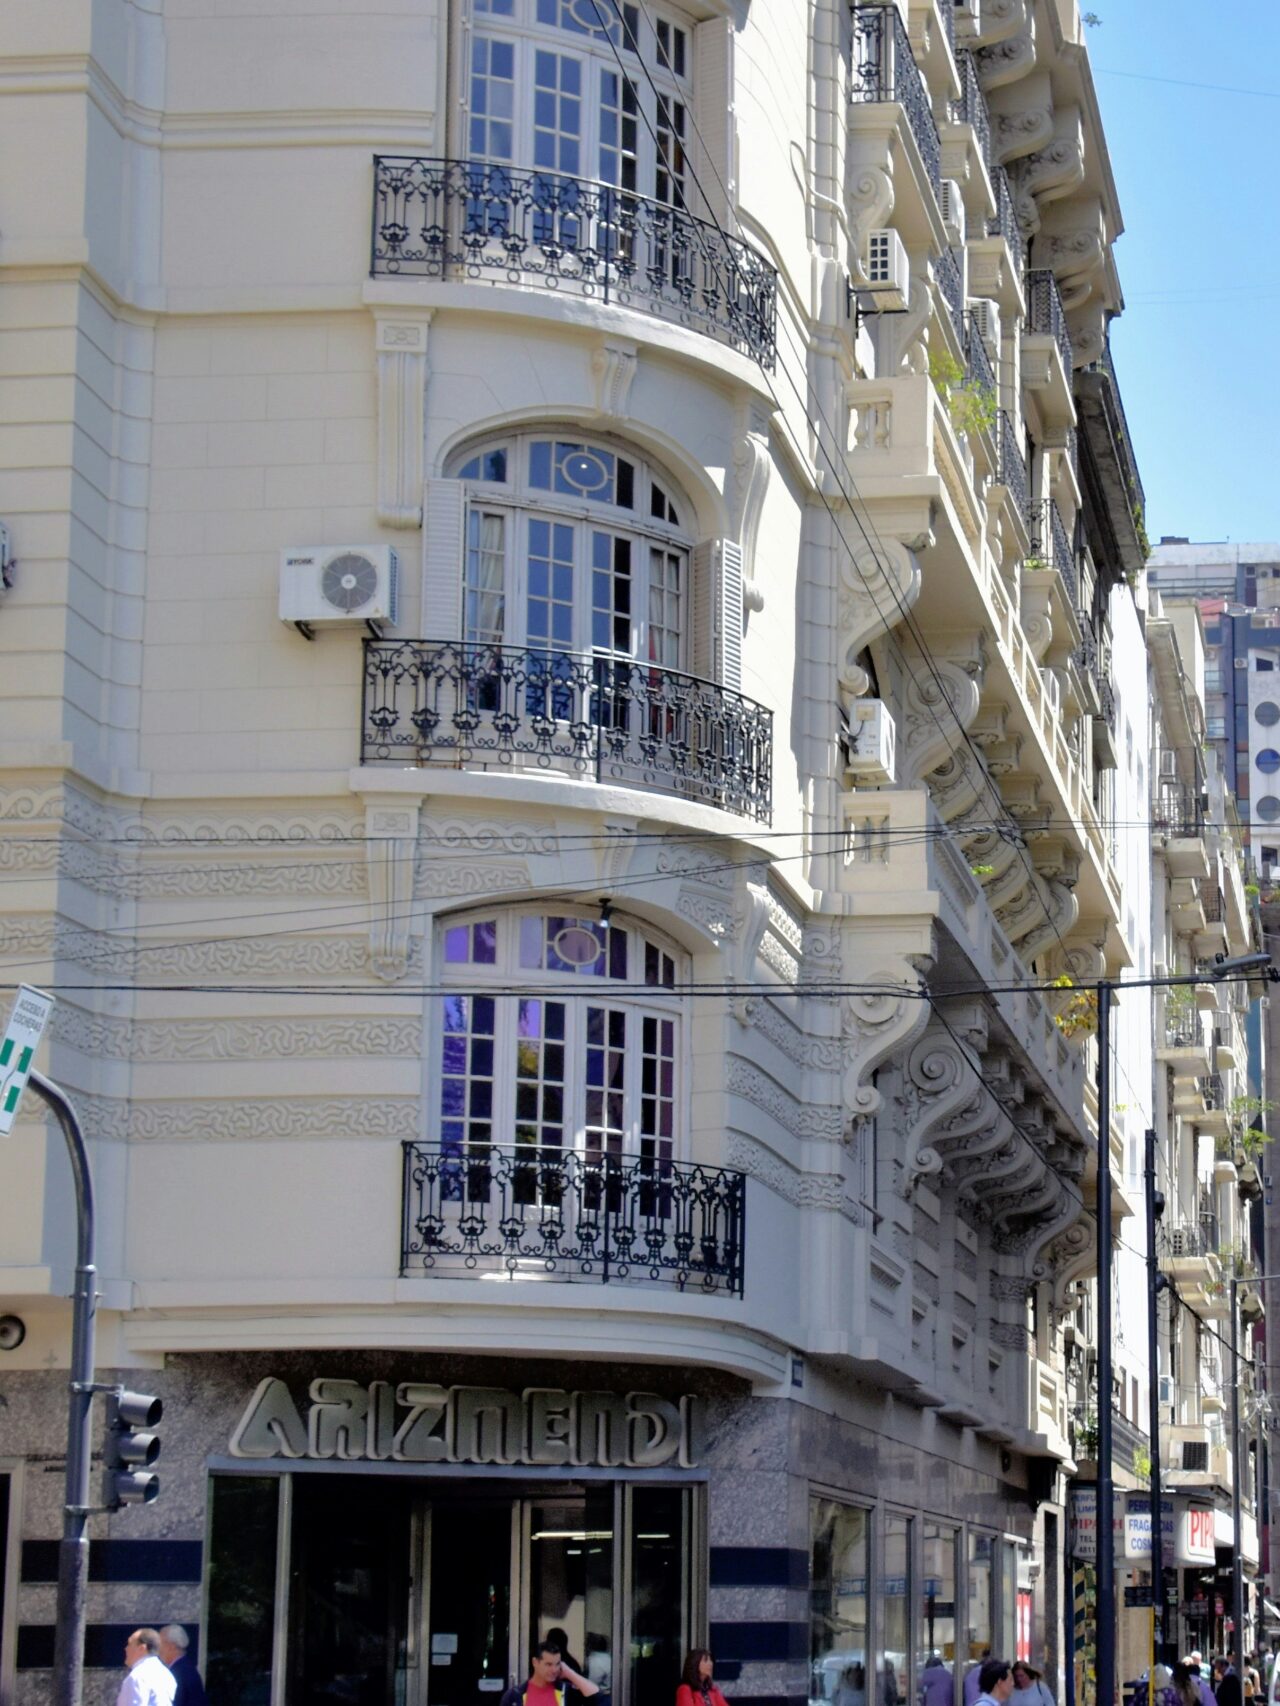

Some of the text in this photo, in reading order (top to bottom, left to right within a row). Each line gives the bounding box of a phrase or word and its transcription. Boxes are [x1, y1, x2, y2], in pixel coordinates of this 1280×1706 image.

[19, 999, 42, 1017] ACCESO
[13, 1012, 43, 1031] COCHERAS
[228, 1376, 699, 1469] ARIZMENDI
